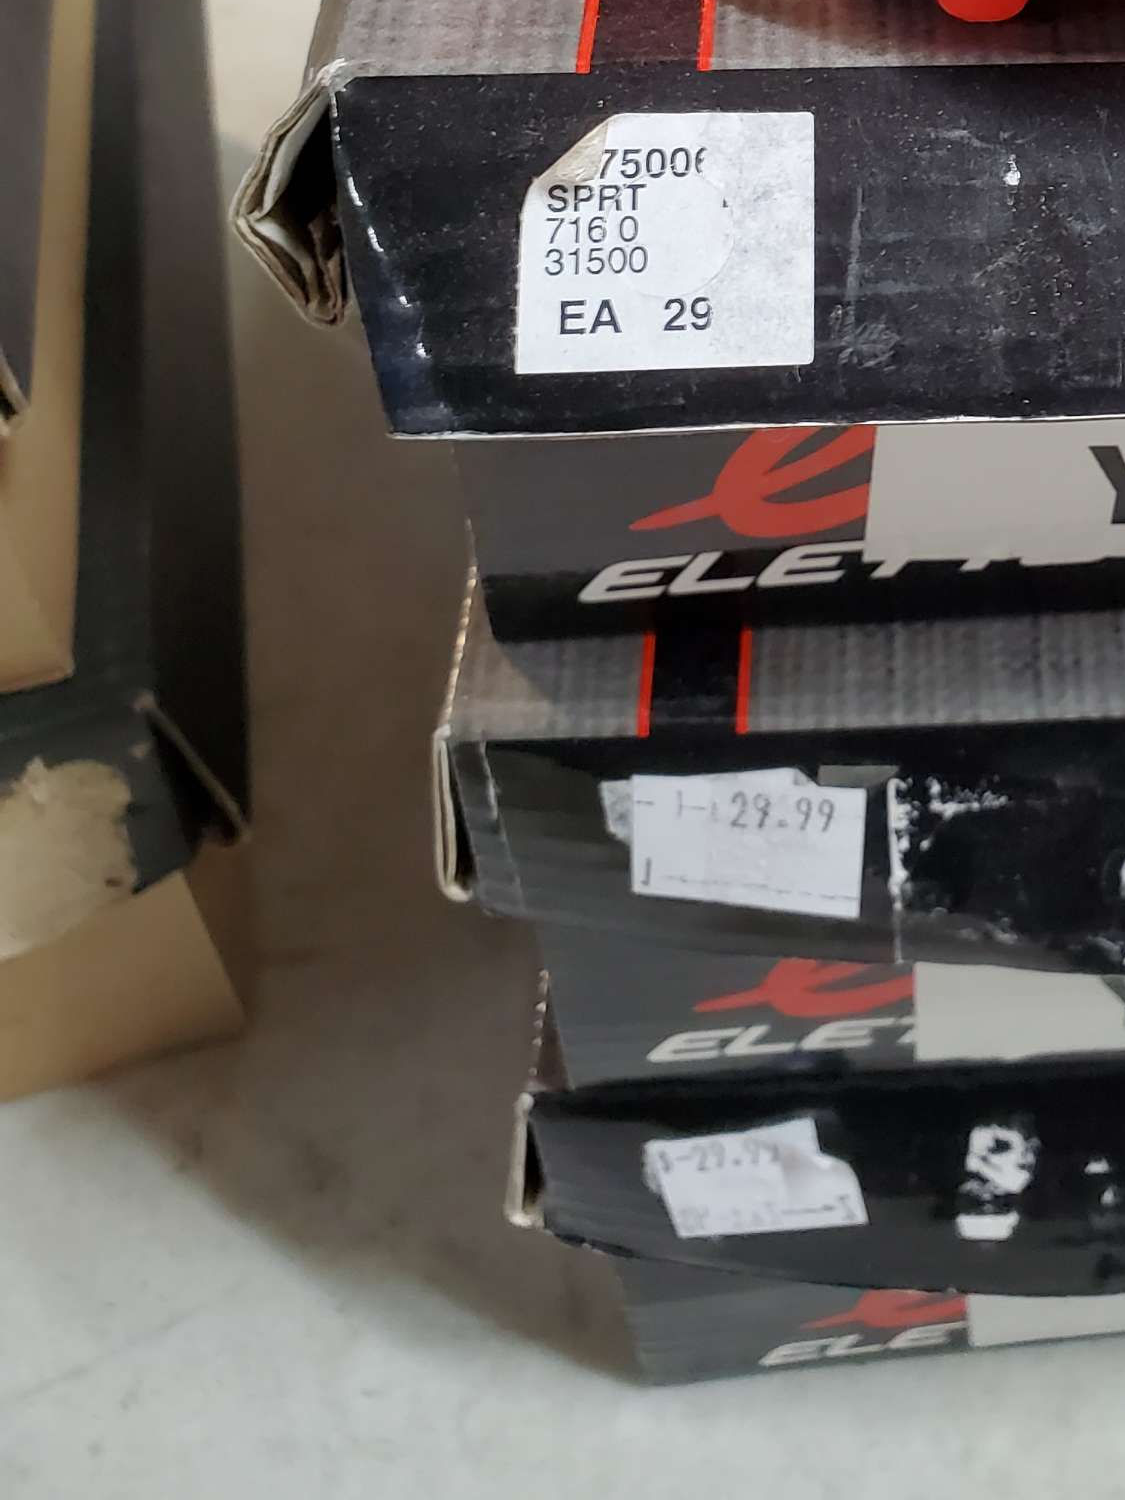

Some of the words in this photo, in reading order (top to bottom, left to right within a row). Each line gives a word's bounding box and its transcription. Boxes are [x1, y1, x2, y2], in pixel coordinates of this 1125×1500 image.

[547, 184, 647, 213] SPRT
[545, 216, 608, 245] 716
[619, 216, 639, 243] 0
[544, 247, 648, 276] 31500
[559, 299, 622, 336] EA
[663, 297, 713, 332] 29
